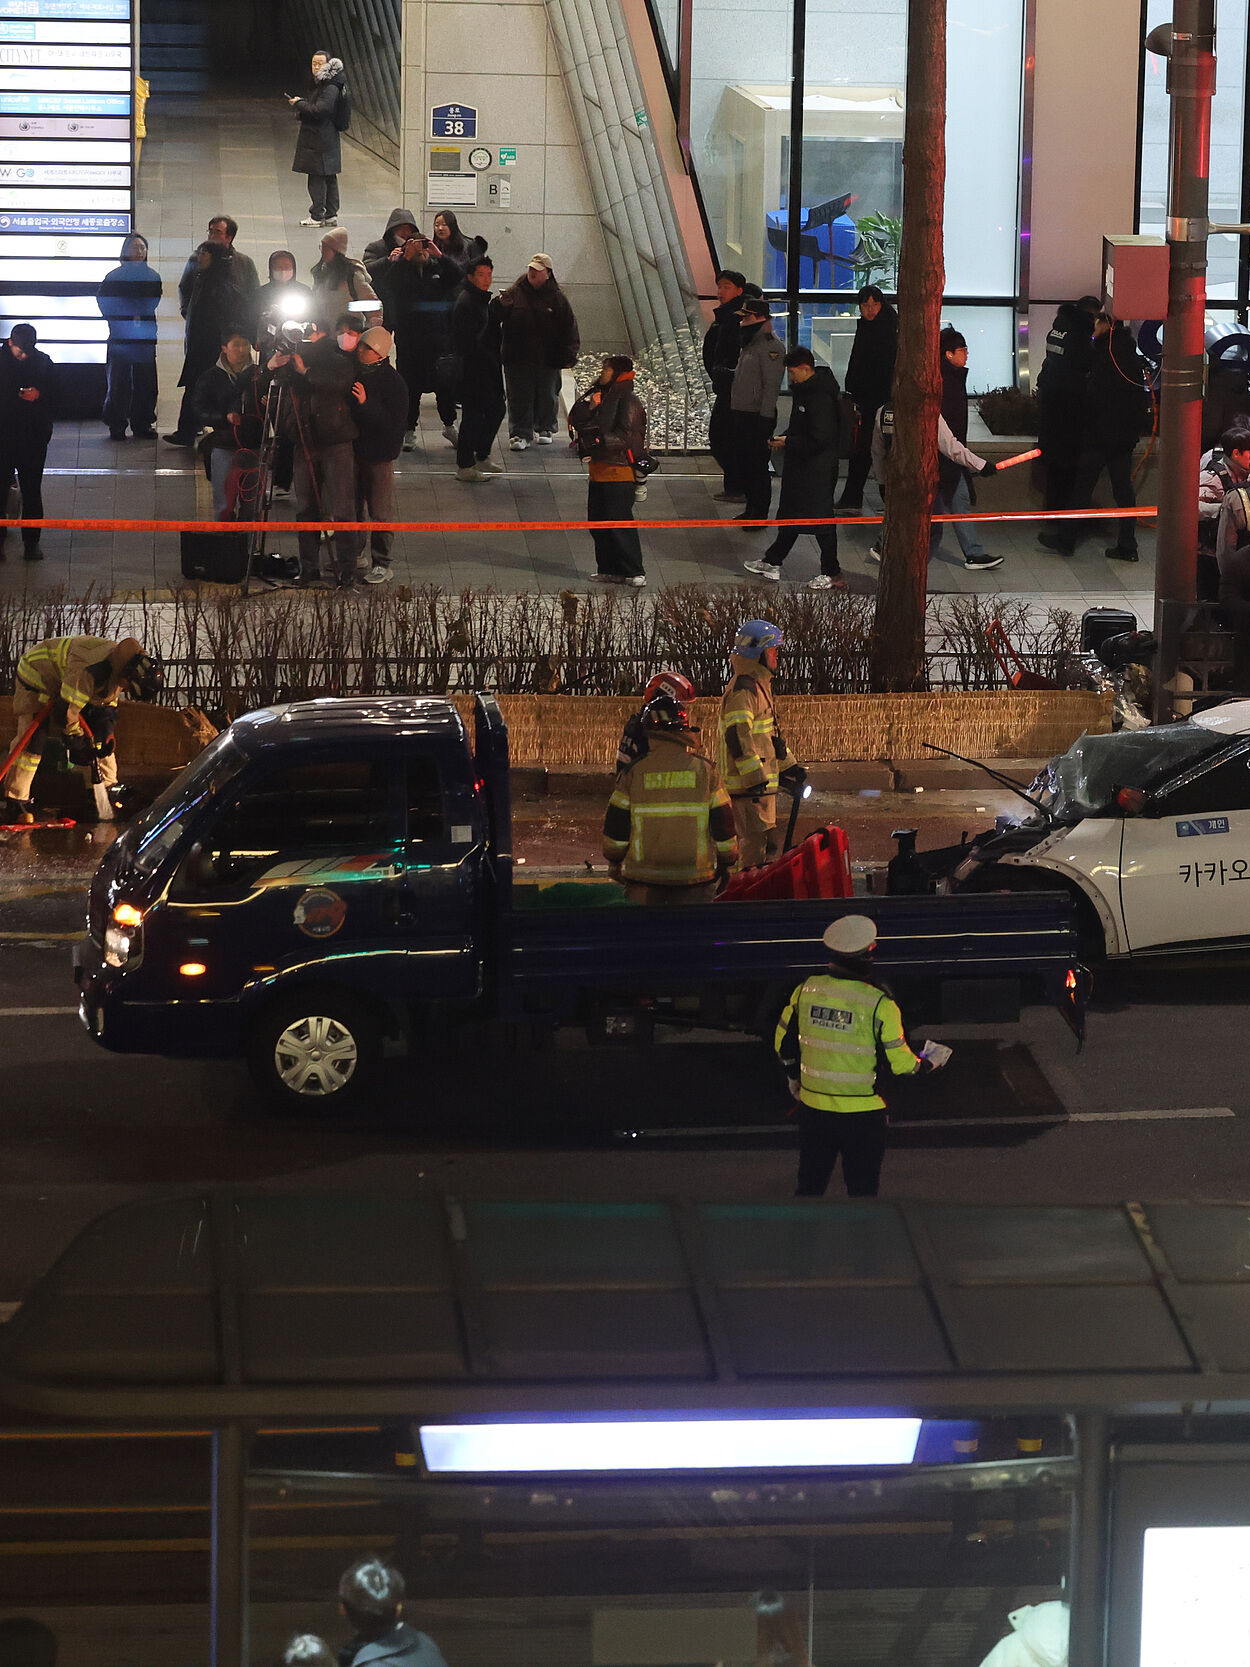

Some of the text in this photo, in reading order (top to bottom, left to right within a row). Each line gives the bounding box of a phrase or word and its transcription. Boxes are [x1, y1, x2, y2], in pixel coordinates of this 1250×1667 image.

[444, 120, 464, 135] 38
[489, 184, 498, 195] B
[81, 218, 125, 227] 세종로출장소
[1208, 819, 1226, 830] 개인
